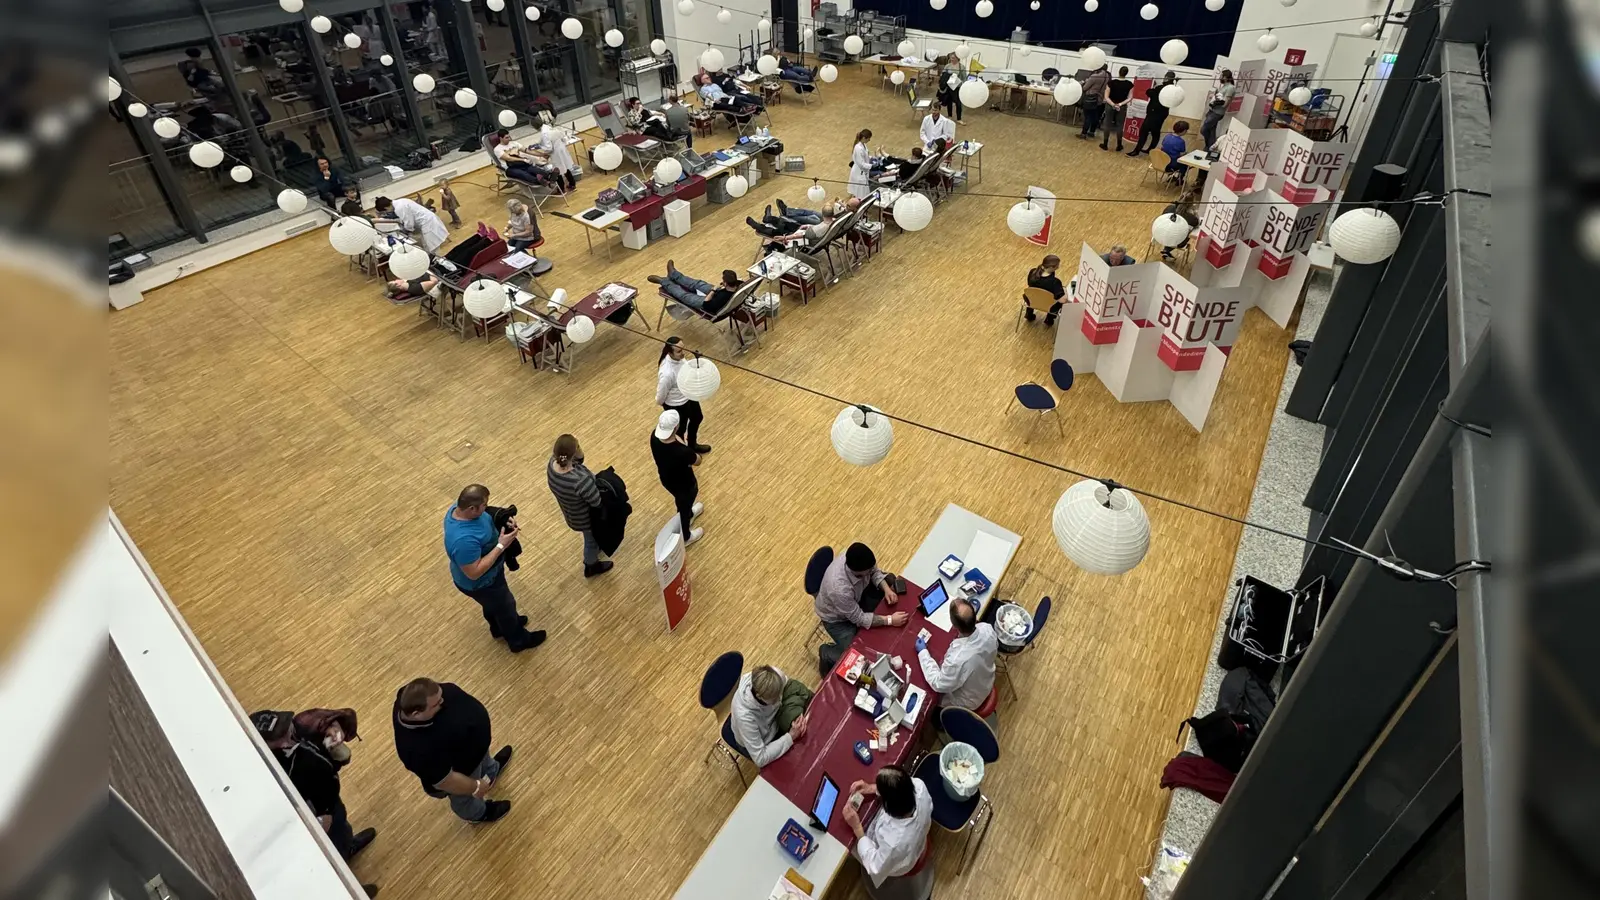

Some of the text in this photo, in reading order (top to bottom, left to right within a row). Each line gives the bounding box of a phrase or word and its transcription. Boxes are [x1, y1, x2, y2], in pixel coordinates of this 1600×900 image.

[1222, 142, 1268, 169] LEBEN
[1228, 131, 1272, 153] SCHENKE
[1288, 143, 1344, 166] SPENDE
[1282, 156, 1339, 184] BLUT
[1210, 196, 1254, 223] SCHENKE
[1267, 206, 1320, 233] SPENDE
[1205, 209, 1249, 242] LEBEN
[1260, 221, 1314, 253] BLUT
[1081, 261, 1140, 297] SCHENKE
[1078, 276, 1137, 318] LEBEN
[1163, 284, 1240, 319] SPENDE
[1158, 300, 1234, 342] BLUT
[662, 562, 669, 573] 3
